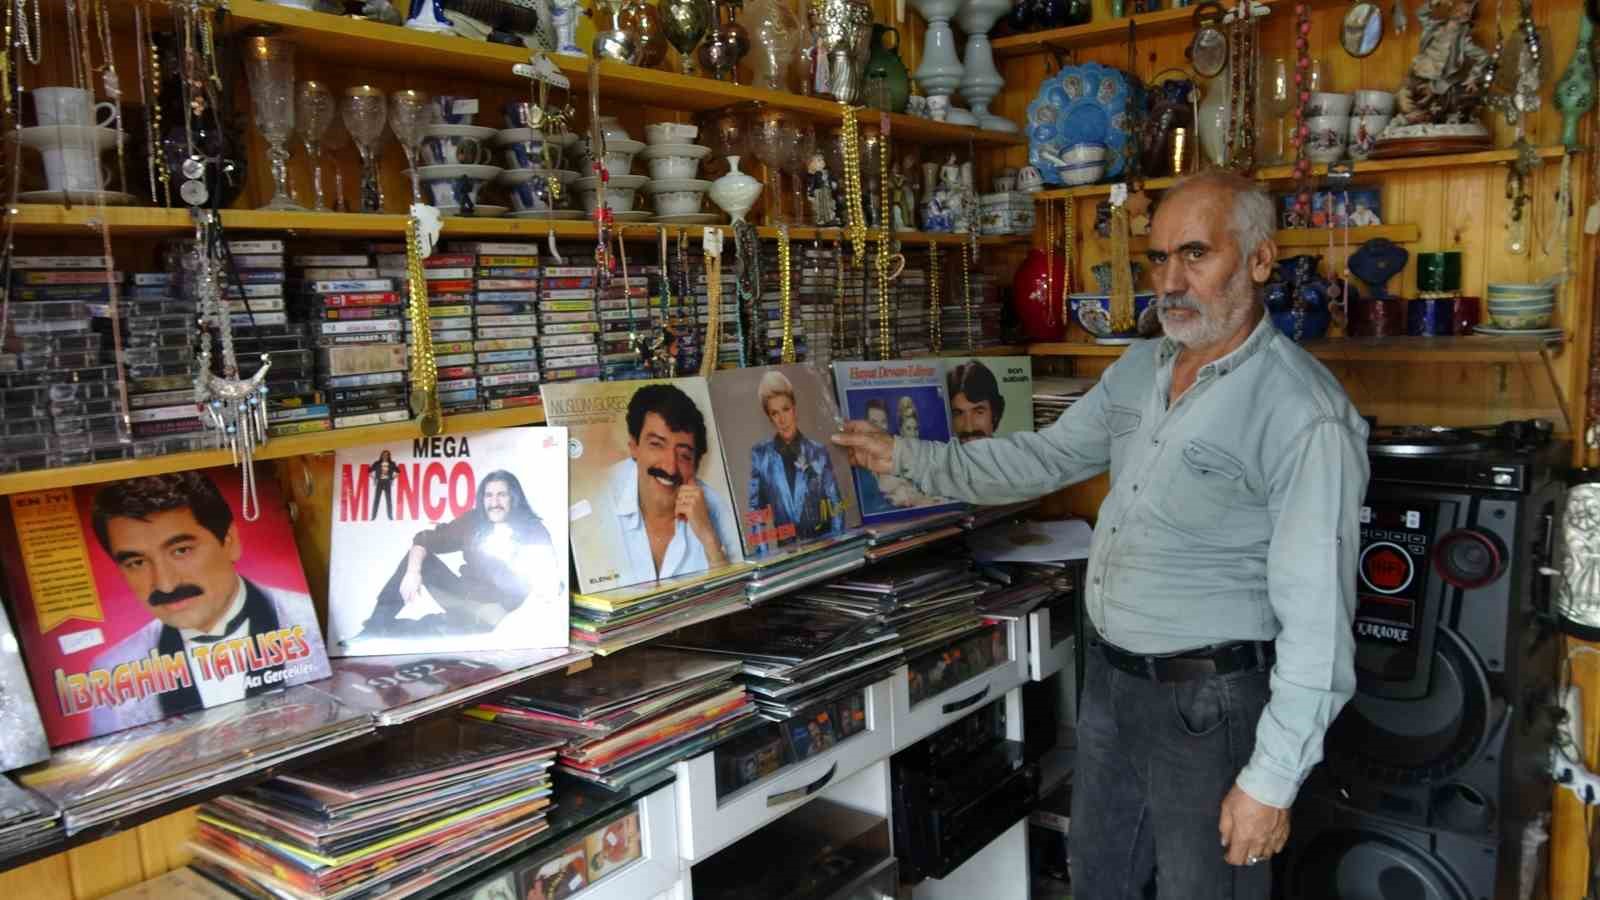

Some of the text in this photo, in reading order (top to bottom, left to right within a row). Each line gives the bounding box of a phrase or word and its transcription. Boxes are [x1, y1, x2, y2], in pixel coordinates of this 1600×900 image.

[1007, 367, 1023, 375] son
[413, 437, 470, 458] MEGA
[1357, 621, 1409, 642] KARAOKE
[54, 624, 312, 718] İBRAHİM TATLISES
